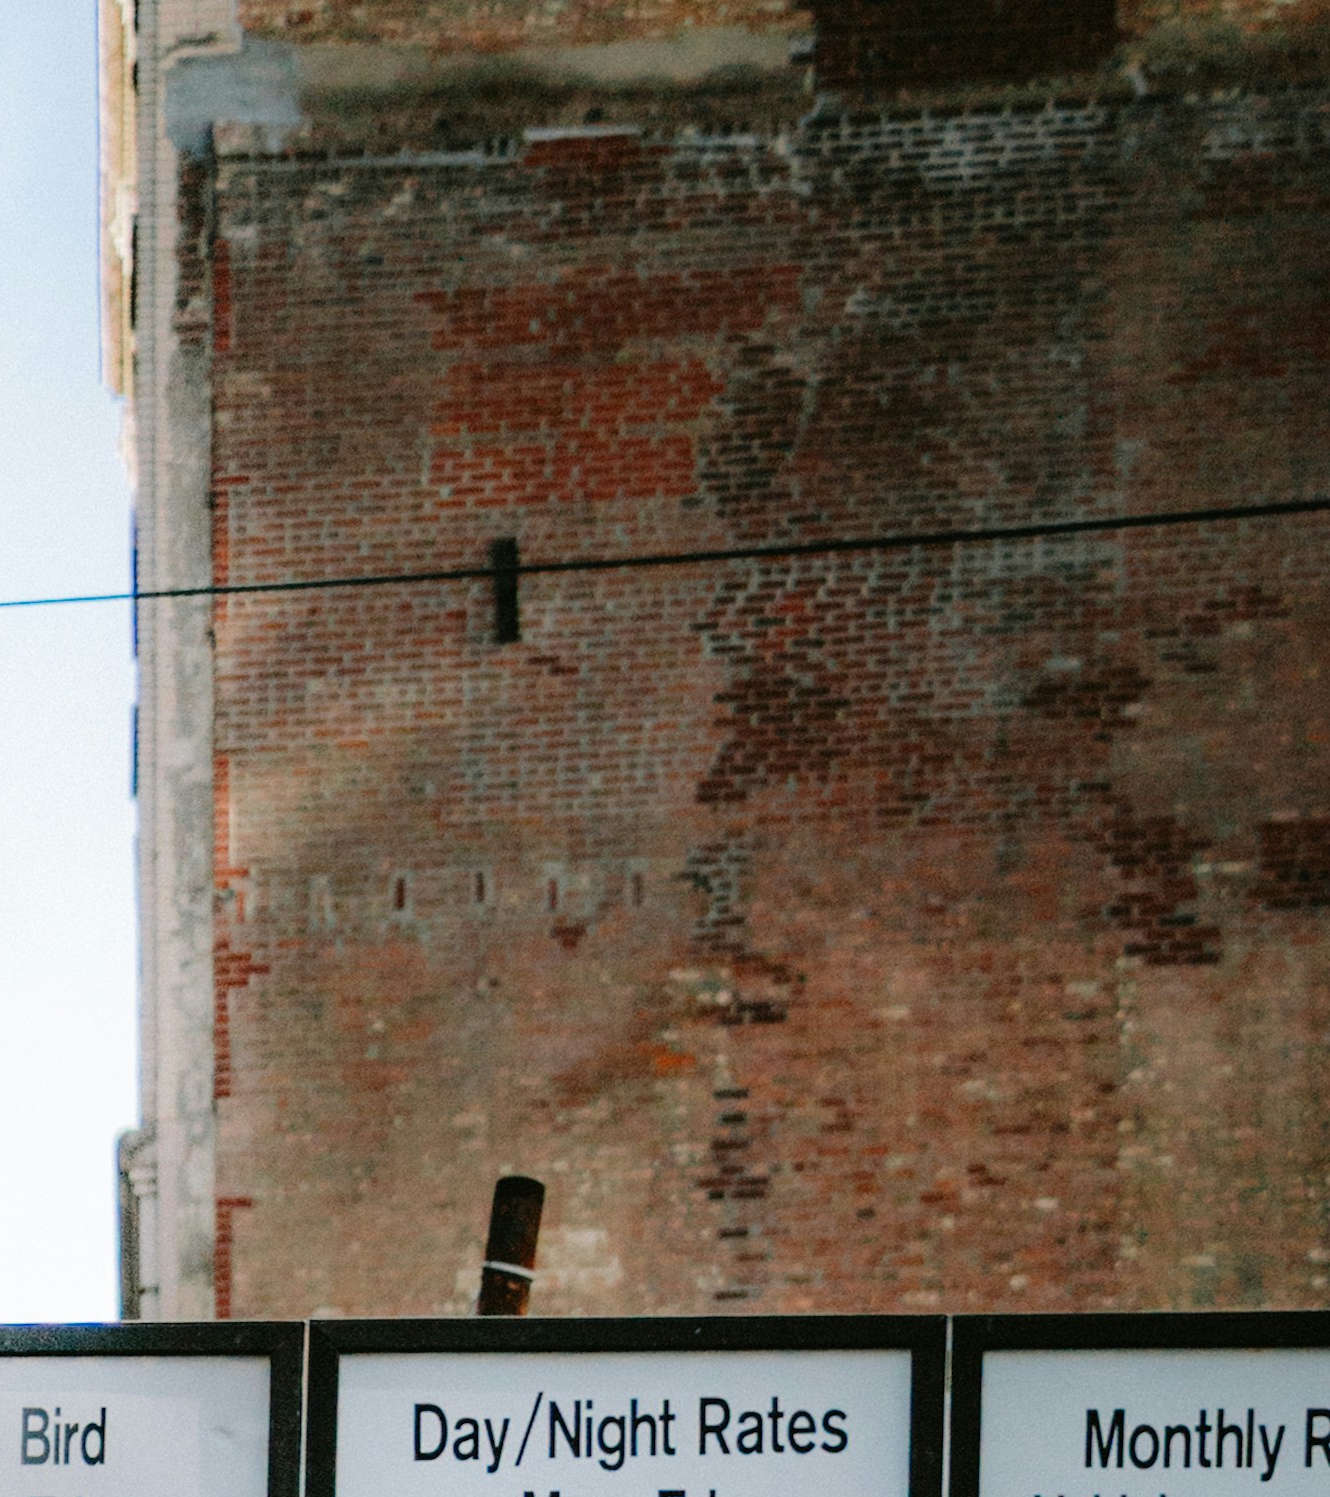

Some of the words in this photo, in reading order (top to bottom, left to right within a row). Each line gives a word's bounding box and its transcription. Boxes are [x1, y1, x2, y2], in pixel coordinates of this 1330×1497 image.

[21, 1406, 107, 1467] Bird
[413, 1391, 676, 1474] Day/Night
[699, 1396, 849, 1456] Rates
[1084, 1408, 1286, 1482] Monthly
